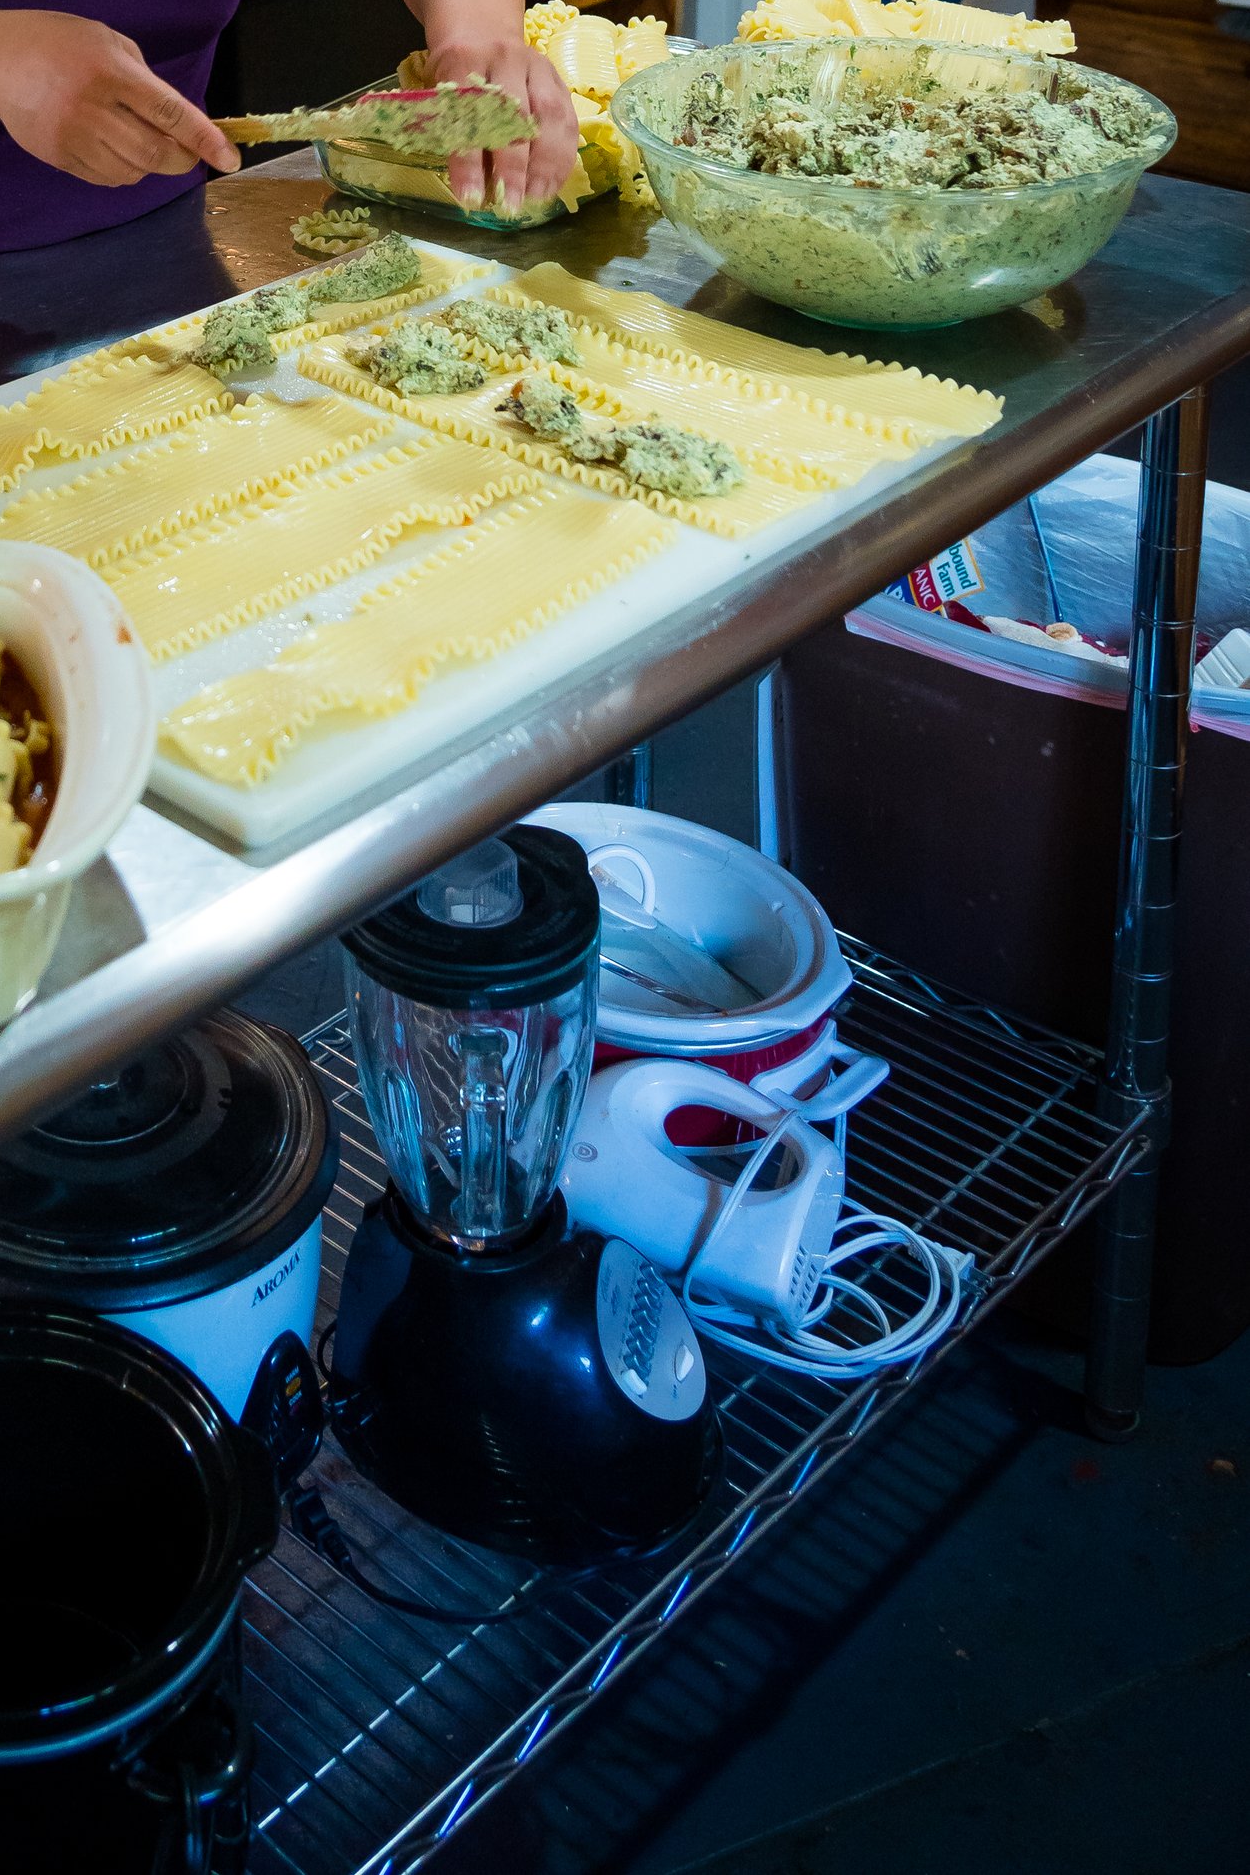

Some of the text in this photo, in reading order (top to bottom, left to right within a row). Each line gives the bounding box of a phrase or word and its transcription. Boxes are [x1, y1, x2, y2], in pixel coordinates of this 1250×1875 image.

[914, 568, 936, 608] ANIC
[936, 561, 955, 598] Farm
[948, 542, 978, 590] bound
[251, 1250, 300, 1307] AROMA
